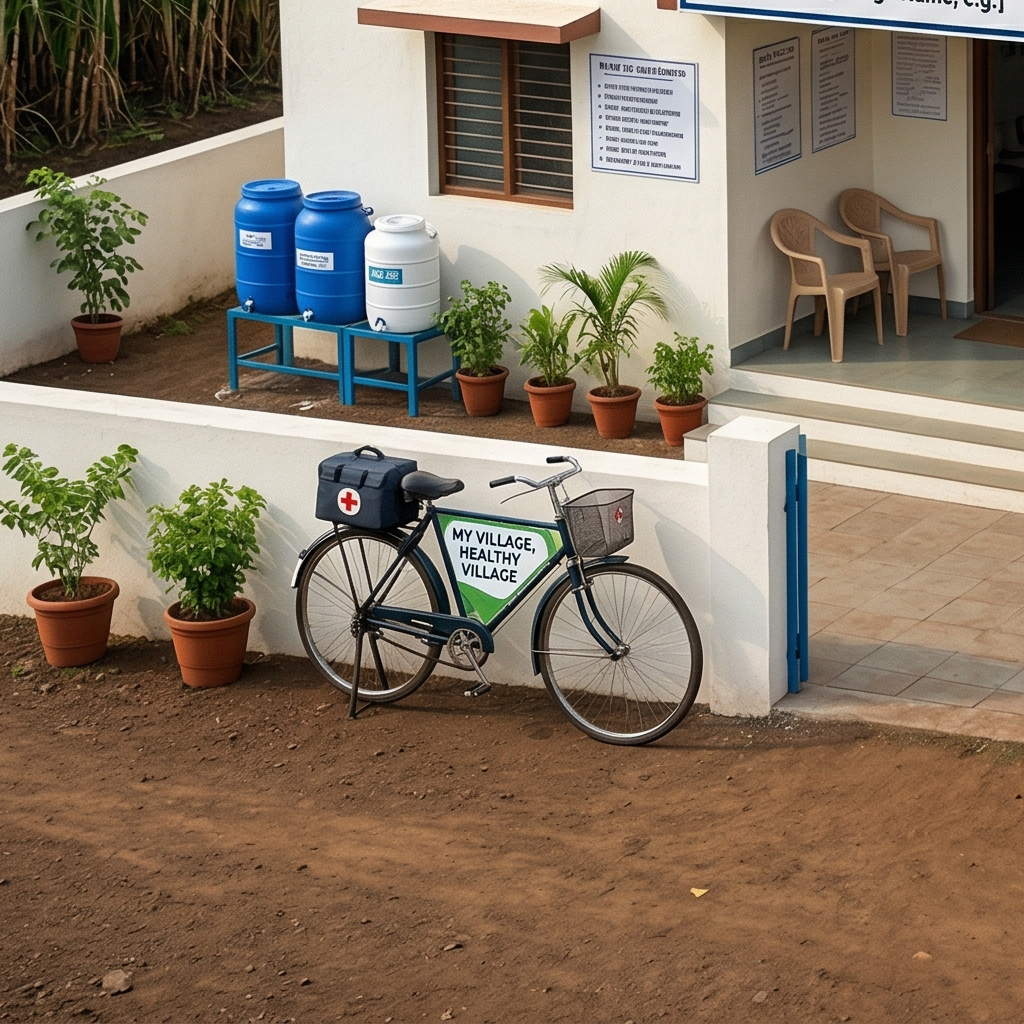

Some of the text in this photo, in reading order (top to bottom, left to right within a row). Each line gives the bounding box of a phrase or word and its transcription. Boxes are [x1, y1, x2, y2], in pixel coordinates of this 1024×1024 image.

[453, 528, 536, 554] MY VILLAGE,
[460, 545, 521, 566] HEALTHY
[461, 562, 517, 583] VILLAGE
